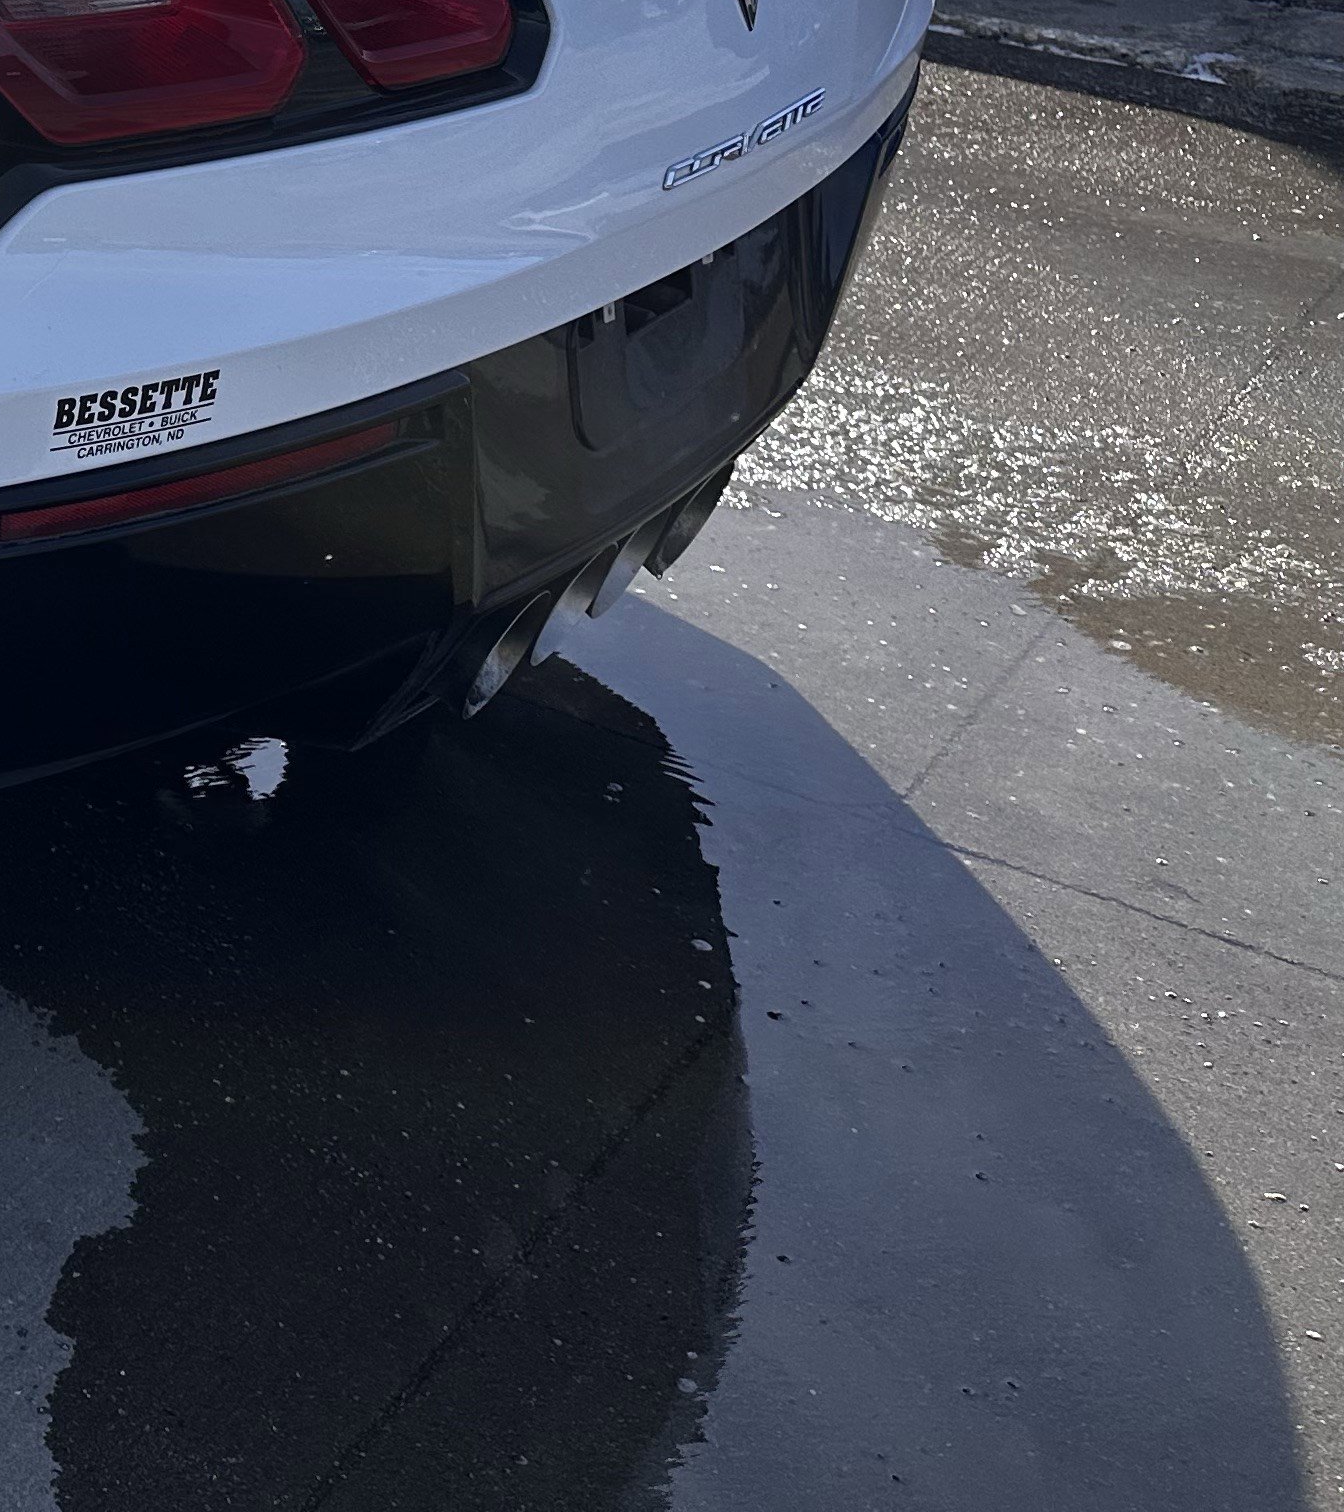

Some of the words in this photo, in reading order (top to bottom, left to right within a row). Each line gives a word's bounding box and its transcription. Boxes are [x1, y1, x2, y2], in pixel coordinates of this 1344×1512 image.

[53, 369, 221, 430] BESSETTE
[68, 420, 146, 445] CHEVROLET
[160, 409, 199, 428] BUICK
[77, 433, 163, 459] CARRINGTON,
[167, 428, 185, 443] ND
